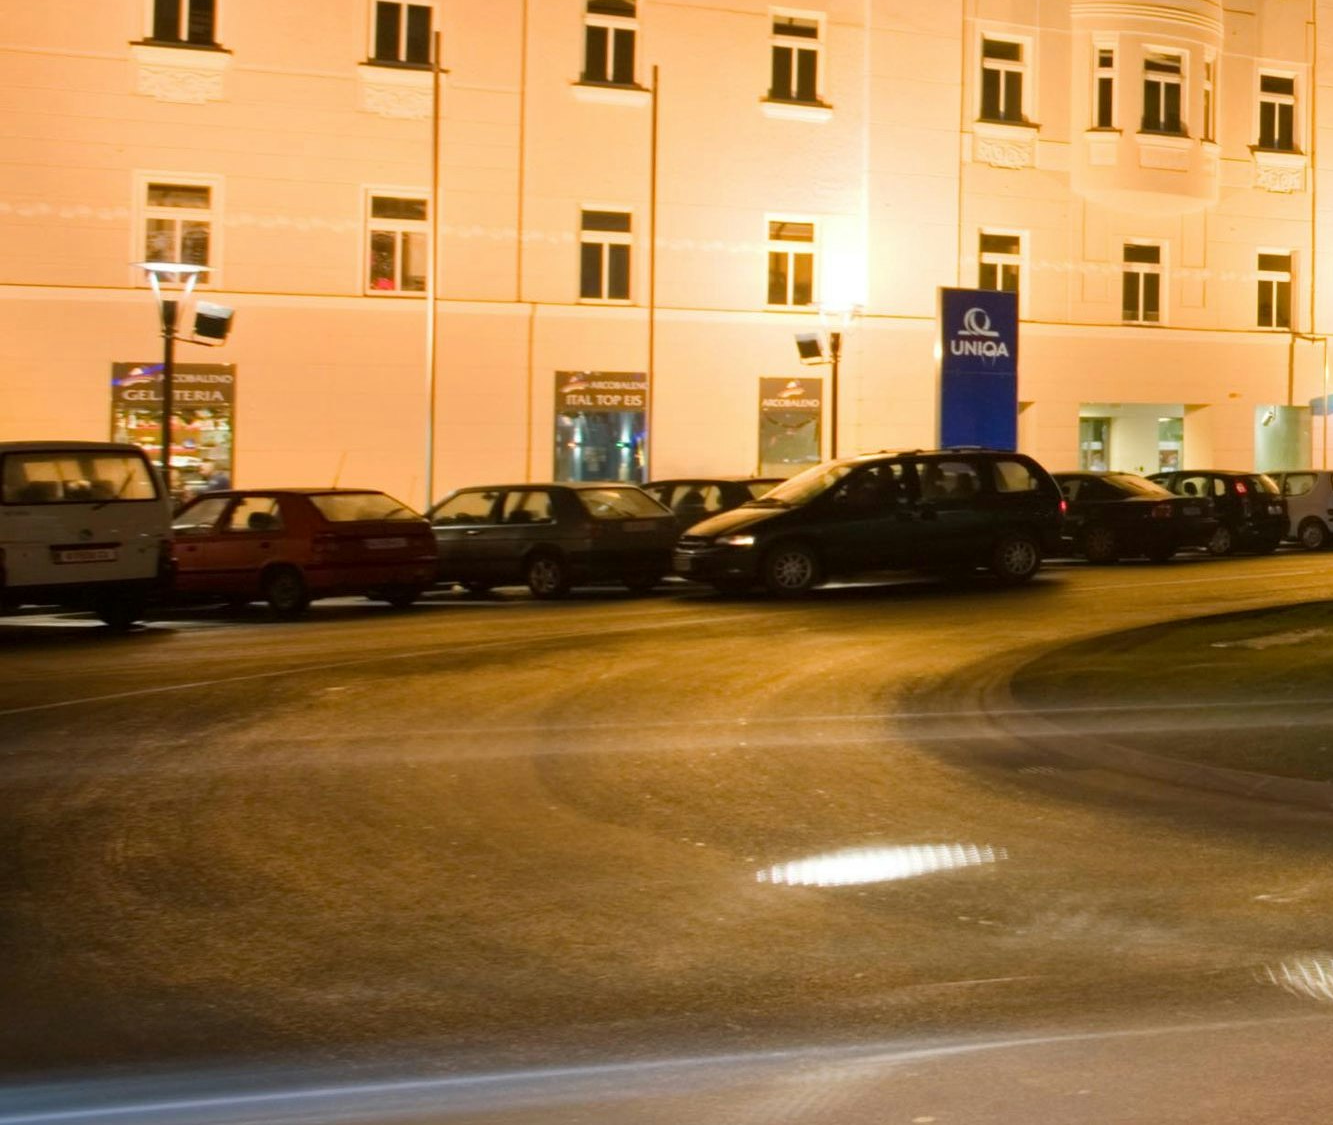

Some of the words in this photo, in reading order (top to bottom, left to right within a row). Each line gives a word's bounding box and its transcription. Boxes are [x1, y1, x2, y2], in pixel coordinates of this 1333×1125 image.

[950, 339, 1010, 358] UNIQA
[122, 389, 225, 401] GELTERIA
[565, 394, 593, 406] ITAL
[596, 394, 622, 406] TOP
[623, 395, 642, 406] EIS
[762, 398, 820, 408] ARCOBALENO
